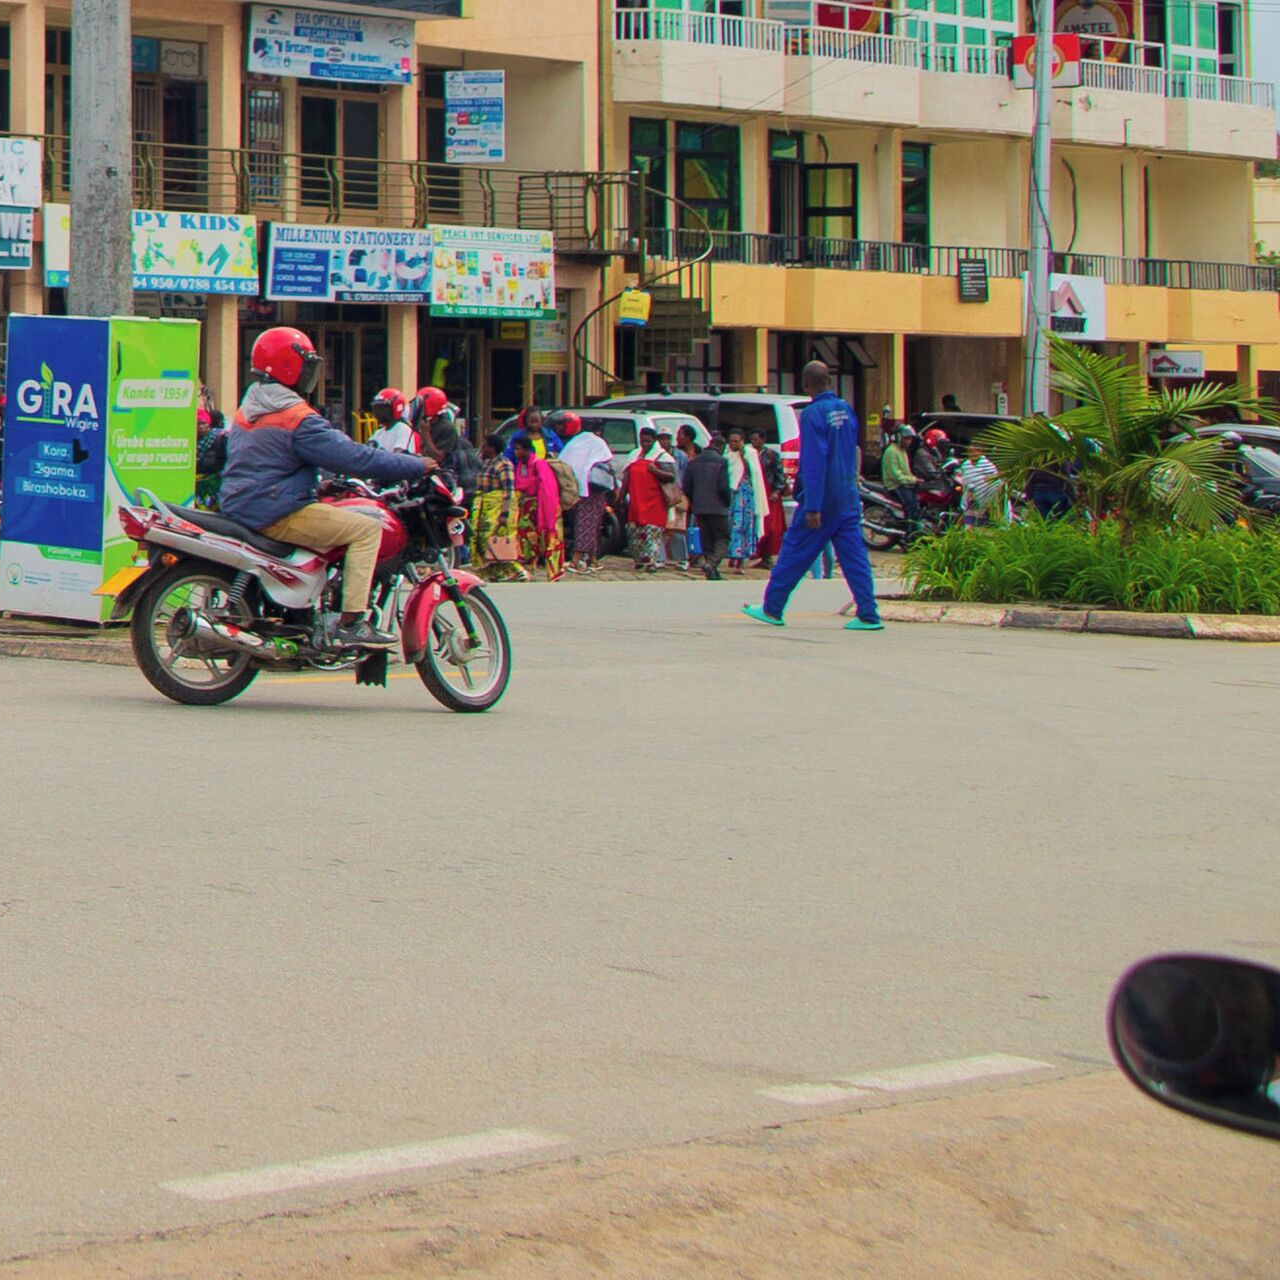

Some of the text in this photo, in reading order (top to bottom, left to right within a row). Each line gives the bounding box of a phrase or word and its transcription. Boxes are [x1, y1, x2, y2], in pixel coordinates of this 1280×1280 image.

[294, 12, 311, 25] EVA
[313, 14, 346, 29] OPTICAL
[1062, 22, 1113, 34] AMSTEL
[180, 213, 241, 232] KIDS
[275, 227, 342, 244] MILLENIUM
[344, 230, 416, 247] STATIONERY
[16, 376, 99, 419] GIRA
[122, 384, 156, 400] Kanda
[64, 415, 100, 432] Wigire
[22, 480, 89, 499] Birashoboka.
